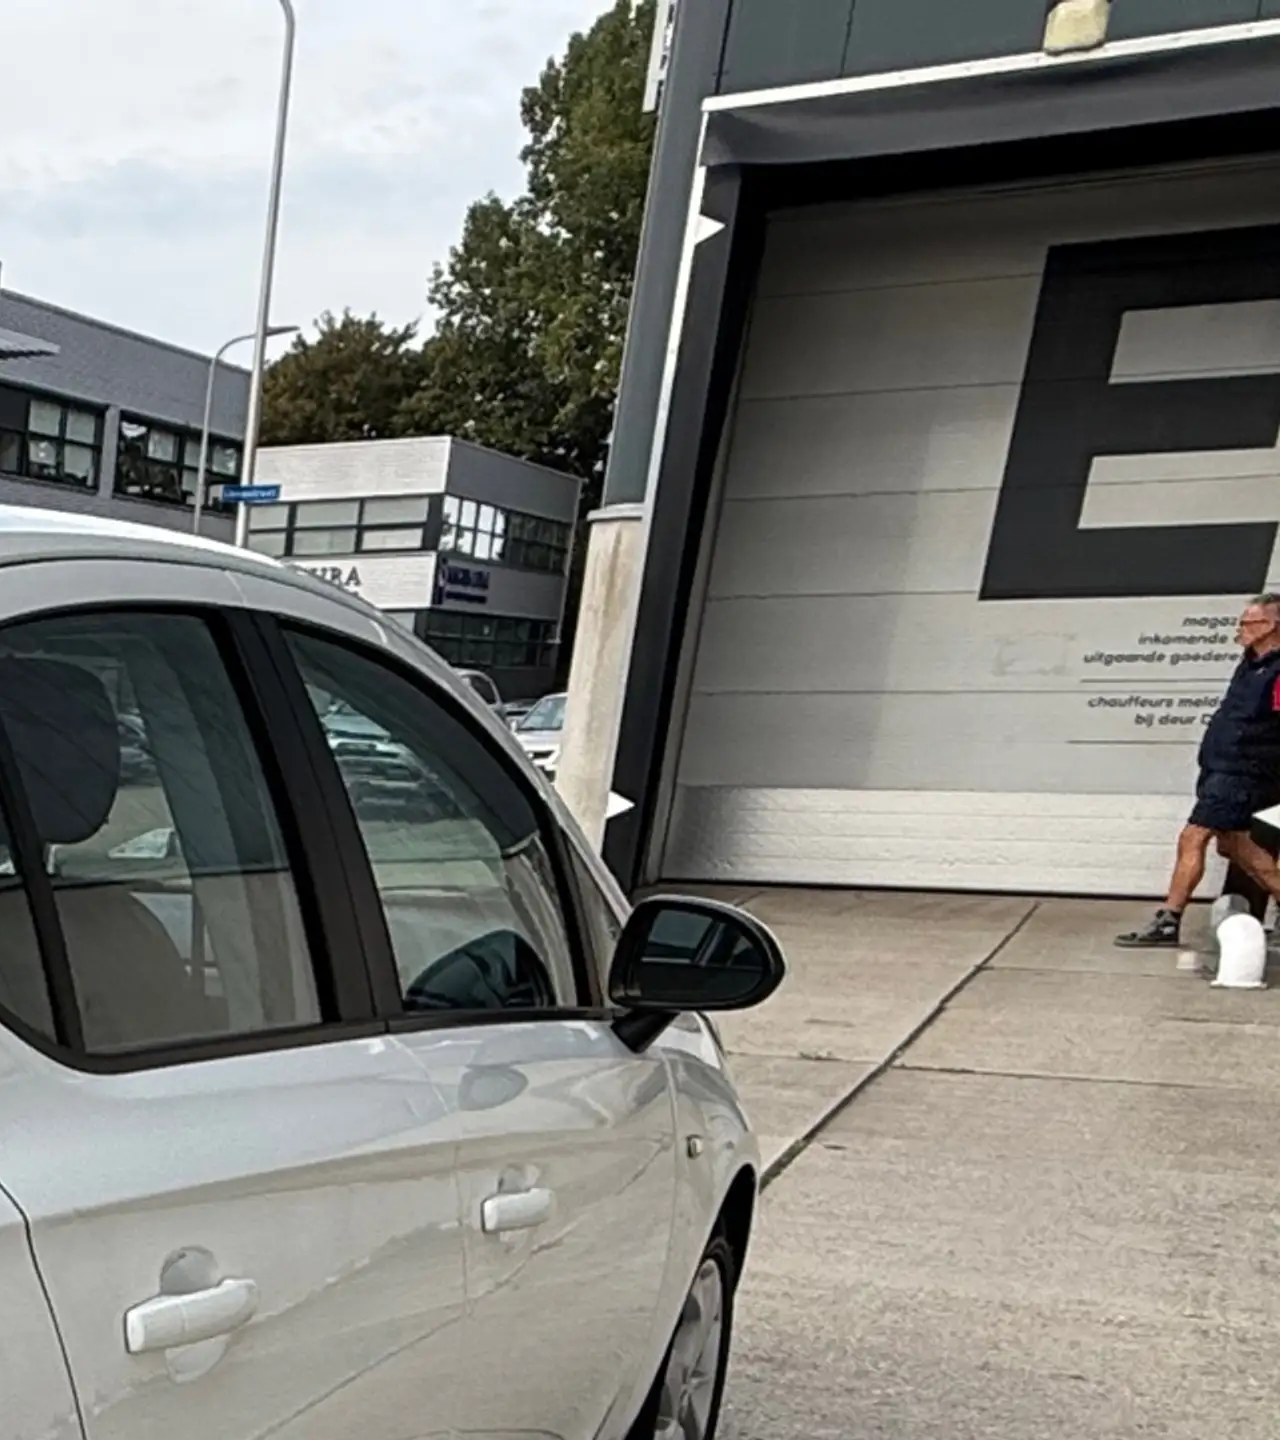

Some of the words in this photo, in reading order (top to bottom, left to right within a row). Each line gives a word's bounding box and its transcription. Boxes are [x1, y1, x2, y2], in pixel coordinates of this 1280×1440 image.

[1182, 616, 1238, 629] magaz
[1138, 634, 1228, 645] inkomende
[1083, 651, 1166, 666] uitgaande
[1170, 650, 1241, 665] goedere
[1088, 695, 1174, 708] chauffeurs
[1177, 695, 1220, 708] meld
[1135, 713, 1155, 727] bij
[1158, 713, 1197, 726] deur
